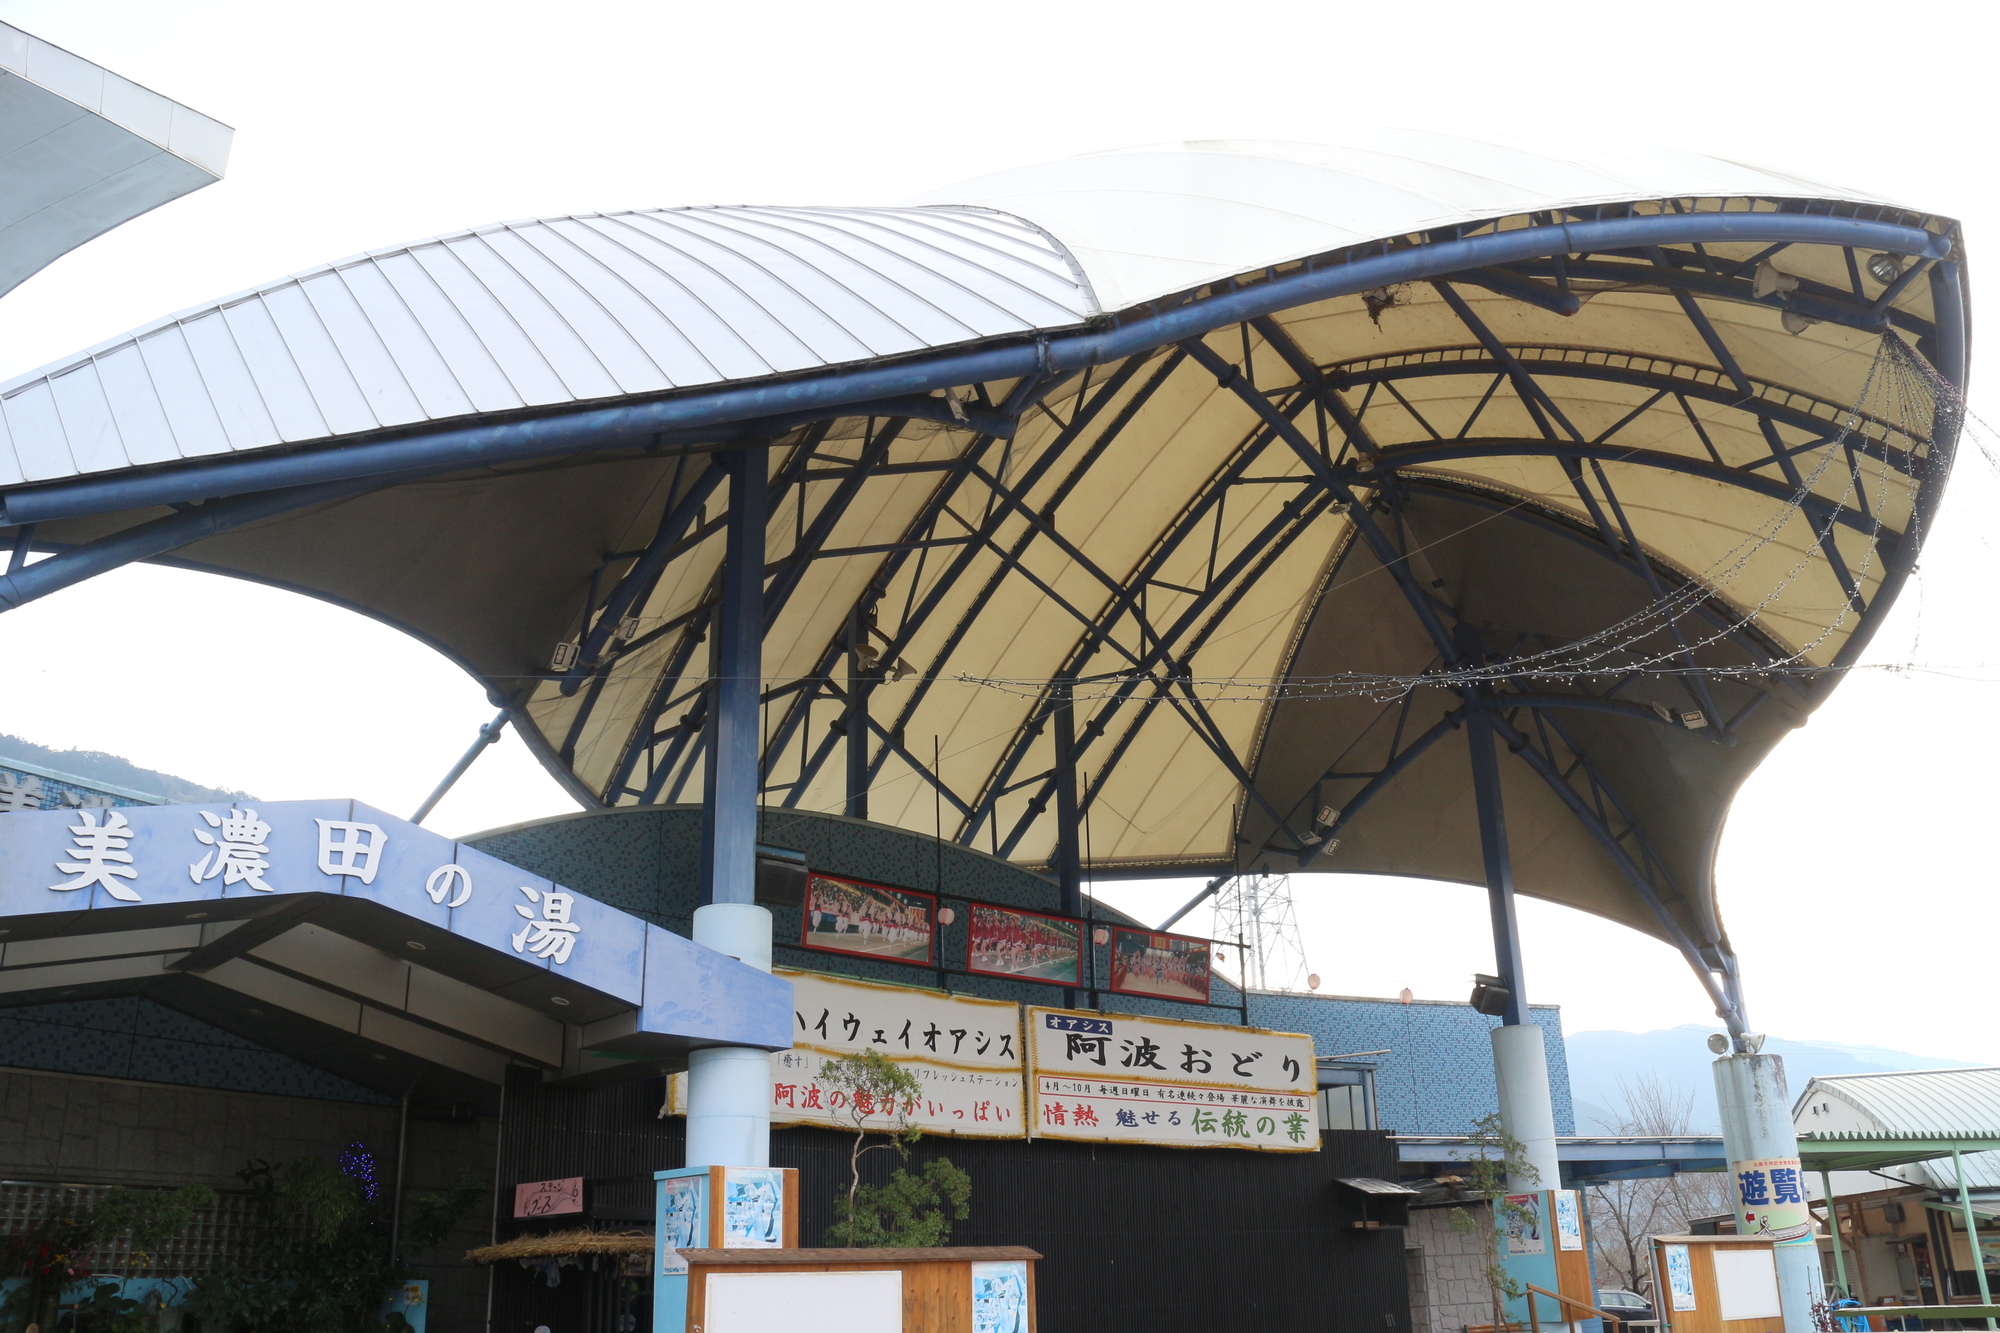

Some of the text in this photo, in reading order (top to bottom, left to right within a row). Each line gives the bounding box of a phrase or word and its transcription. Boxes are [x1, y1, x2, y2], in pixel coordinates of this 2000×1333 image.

[48, 807, 581, 965] 美濃田の湯
[1049, 1016, 1110, 1034] オアシス
[1066, 1033, 1300, 1083] 阿波おどり
[774, 1082, 1011, 1123] 阿波の魅力がいっぱい
[1098, 1084, 1150, 1098] 毎週日曜日
[1043, 1101, 1310, 1144] 情熱 魅せる 伝統の業
